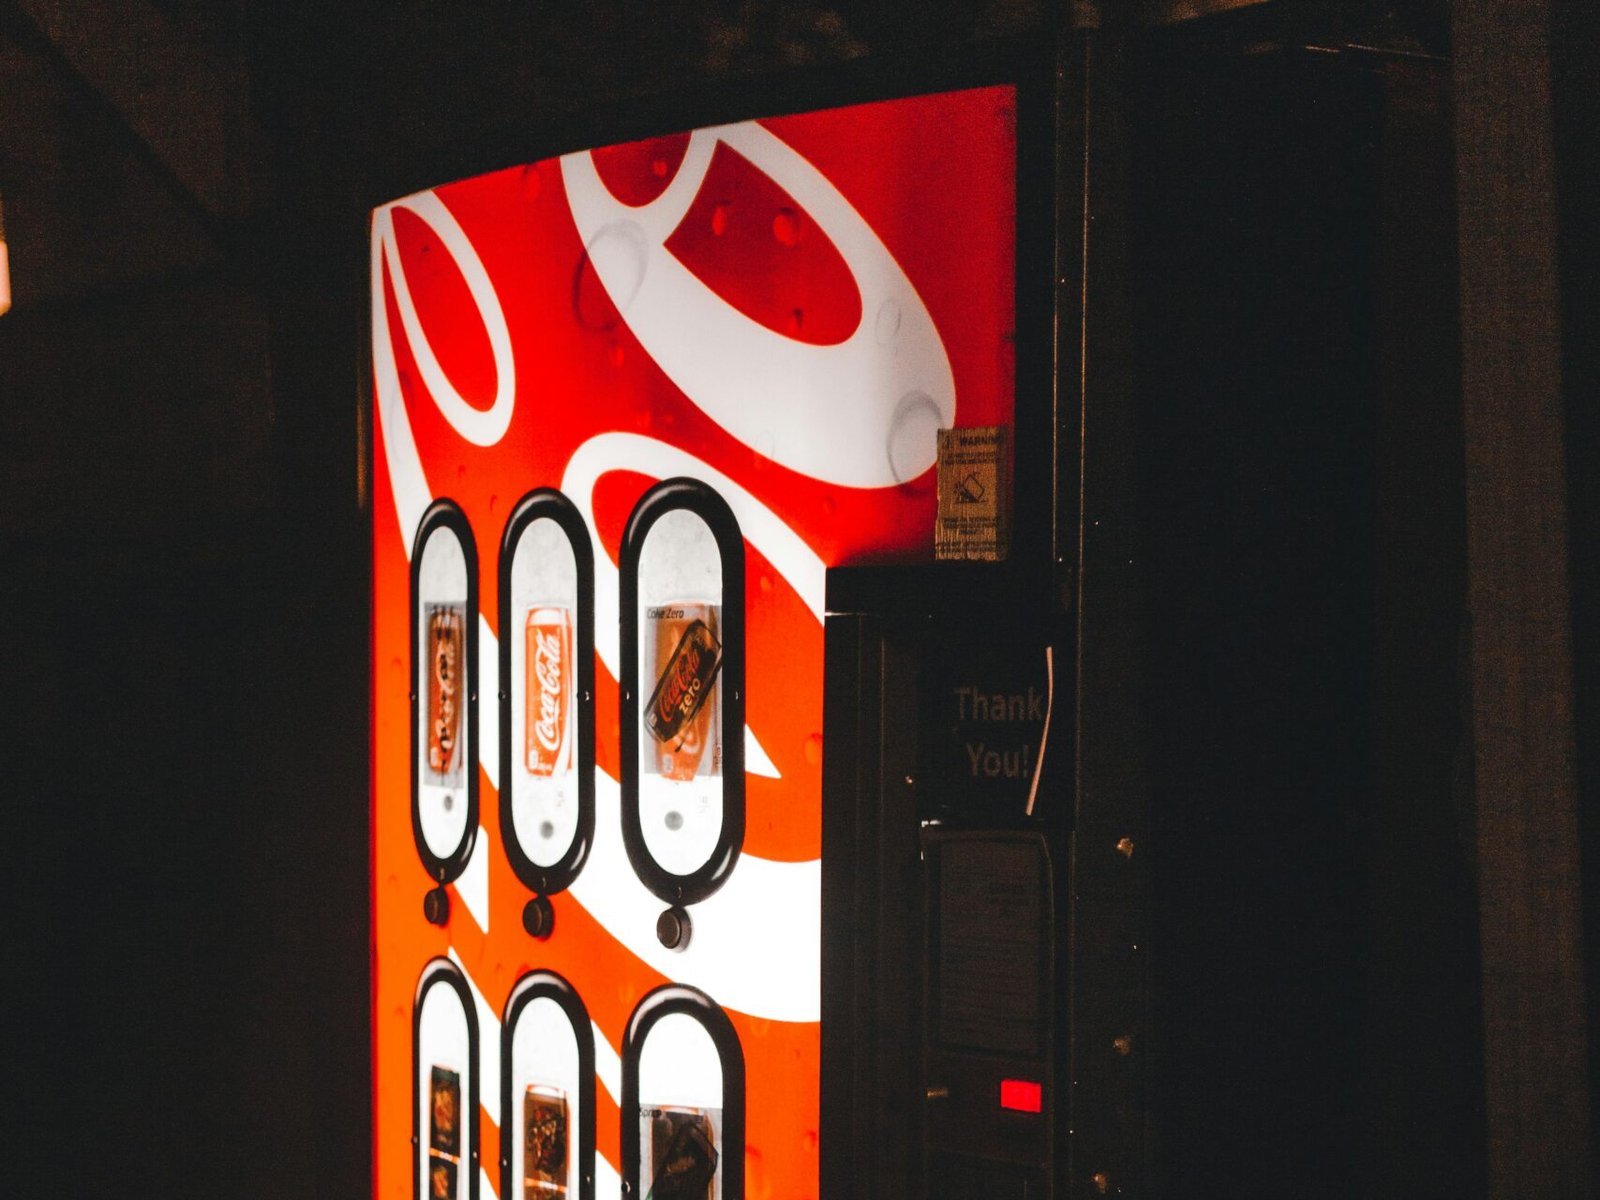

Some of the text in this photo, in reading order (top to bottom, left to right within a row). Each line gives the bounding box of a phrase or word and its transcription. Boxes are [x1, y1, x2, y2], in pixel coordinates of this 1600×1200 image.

[666, 608, 685, 619] Zero
[535, 628, 561, 751] Coca-Cola
[679, 678, 701, 714] zero
[953, 685, 1042, 721] Thank
[965, 742, 1030, 778] You!
